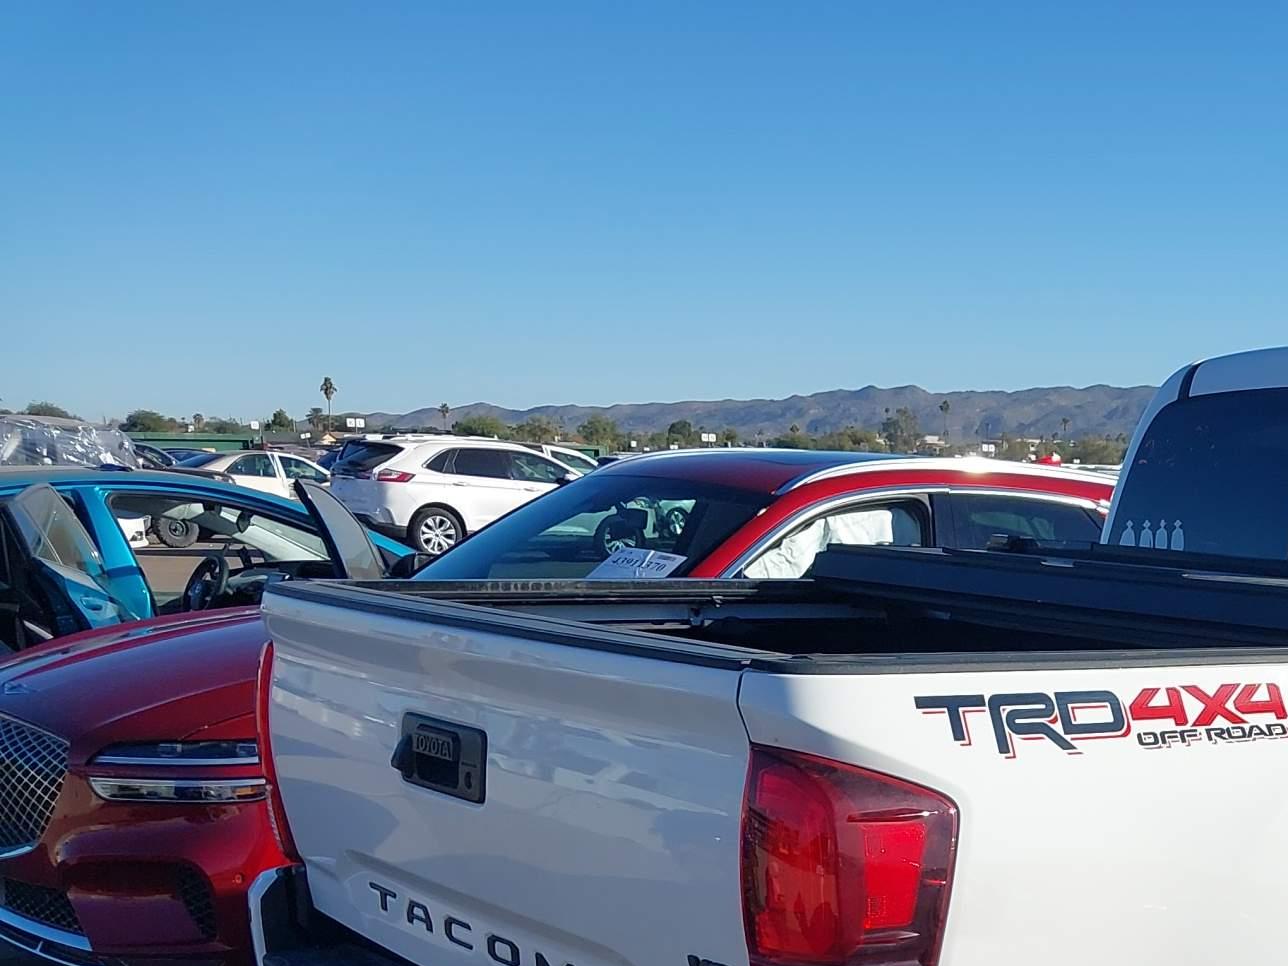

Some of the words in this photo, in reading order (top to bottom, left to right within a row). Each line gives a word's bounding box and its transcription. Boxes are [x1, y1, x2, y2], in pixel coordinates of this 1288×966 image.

[914, 690, 1131, 759] TRD
[413, 734, 454, 760] TOYOTA
[1136, 728, 1203, 749] OFF
